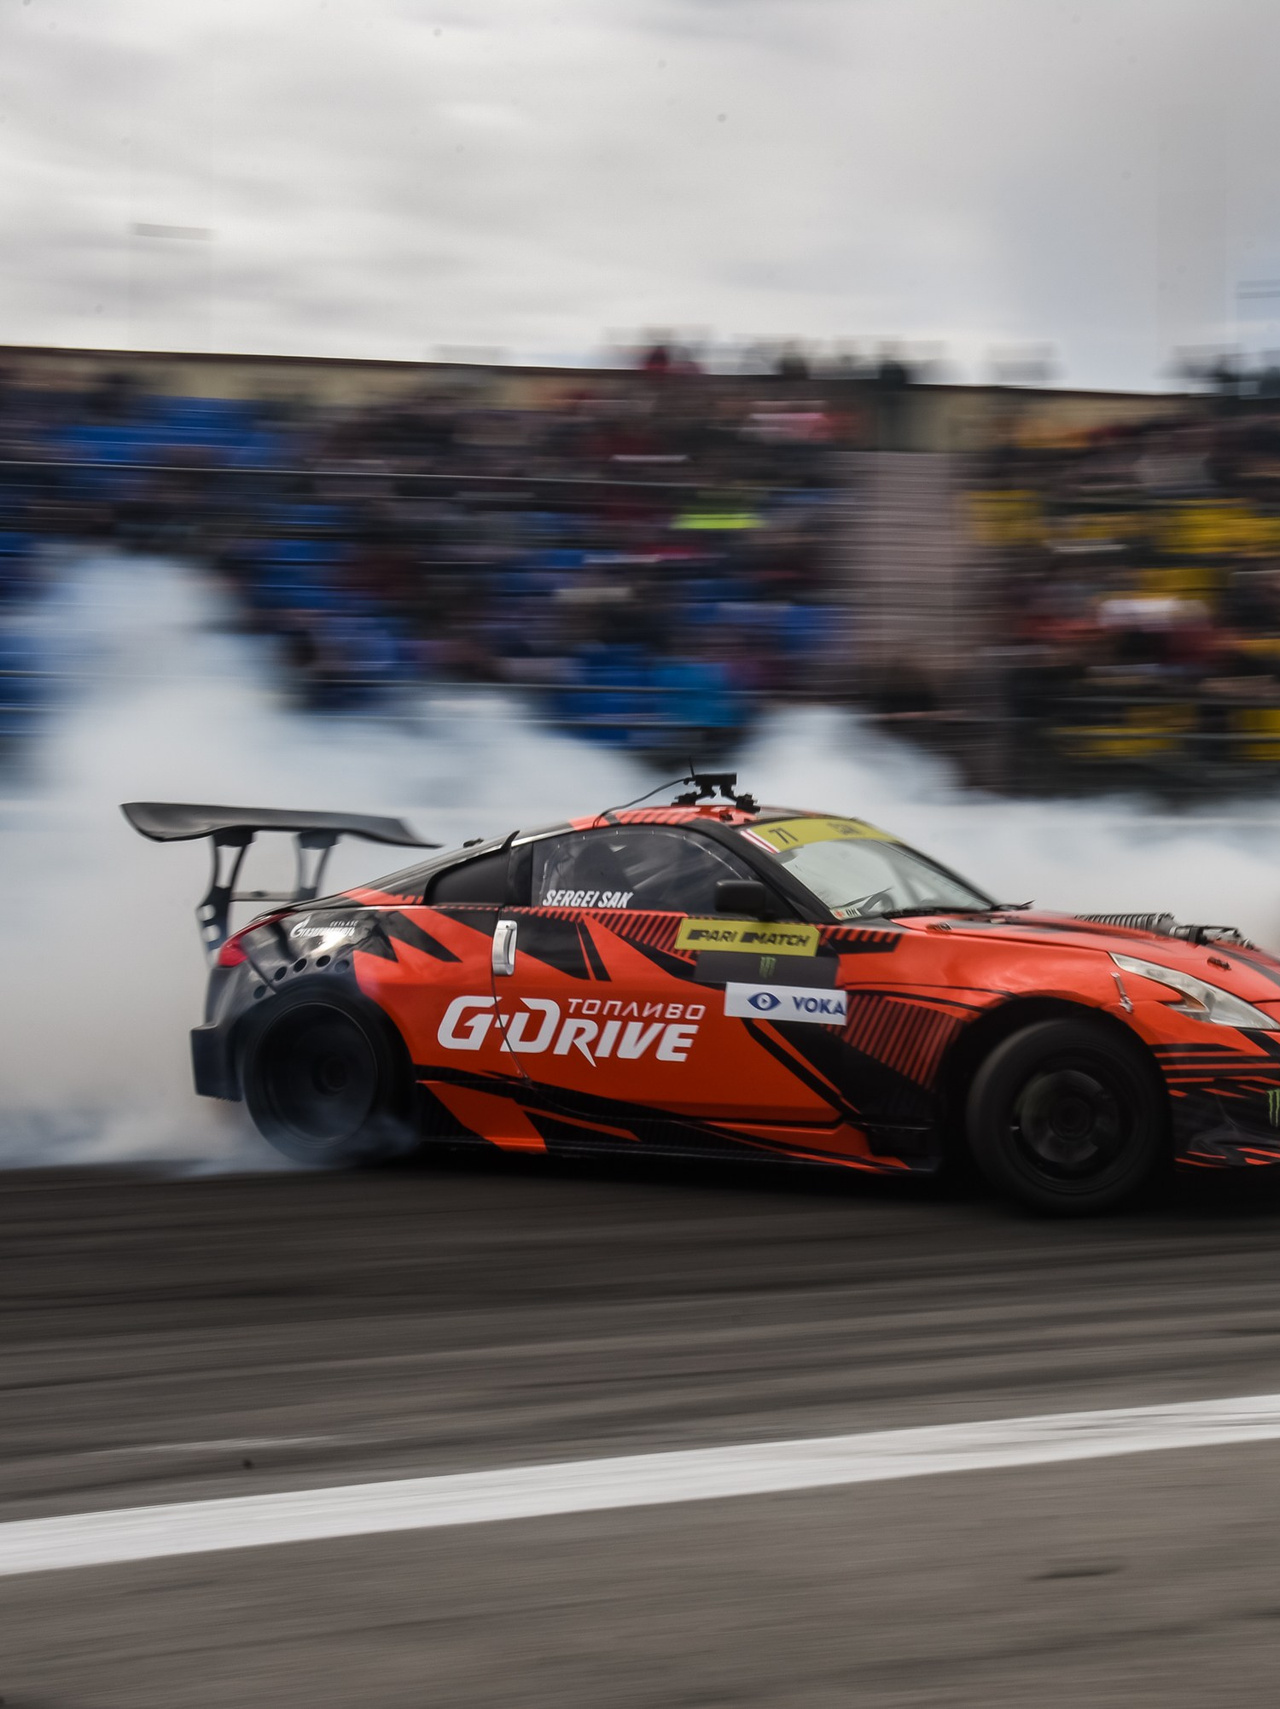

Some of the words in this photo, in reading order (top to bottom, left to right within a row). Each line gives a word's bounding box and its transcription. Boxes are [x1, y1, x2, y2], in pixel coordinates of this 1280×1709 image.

[768, 827, 799, 844] 71
[542, 889, 600, 907] SERGEI
[598, 890, 634, 909] SAK
[687, 929, 738, 943] PARI
[741, 931, 811, 947] MATCH
[568, 998, 706, 1020] ТОПЛИВО
[792, 995, 847, 1016] VOKA
[437, 995, 699, 1068] G-DRIVE
